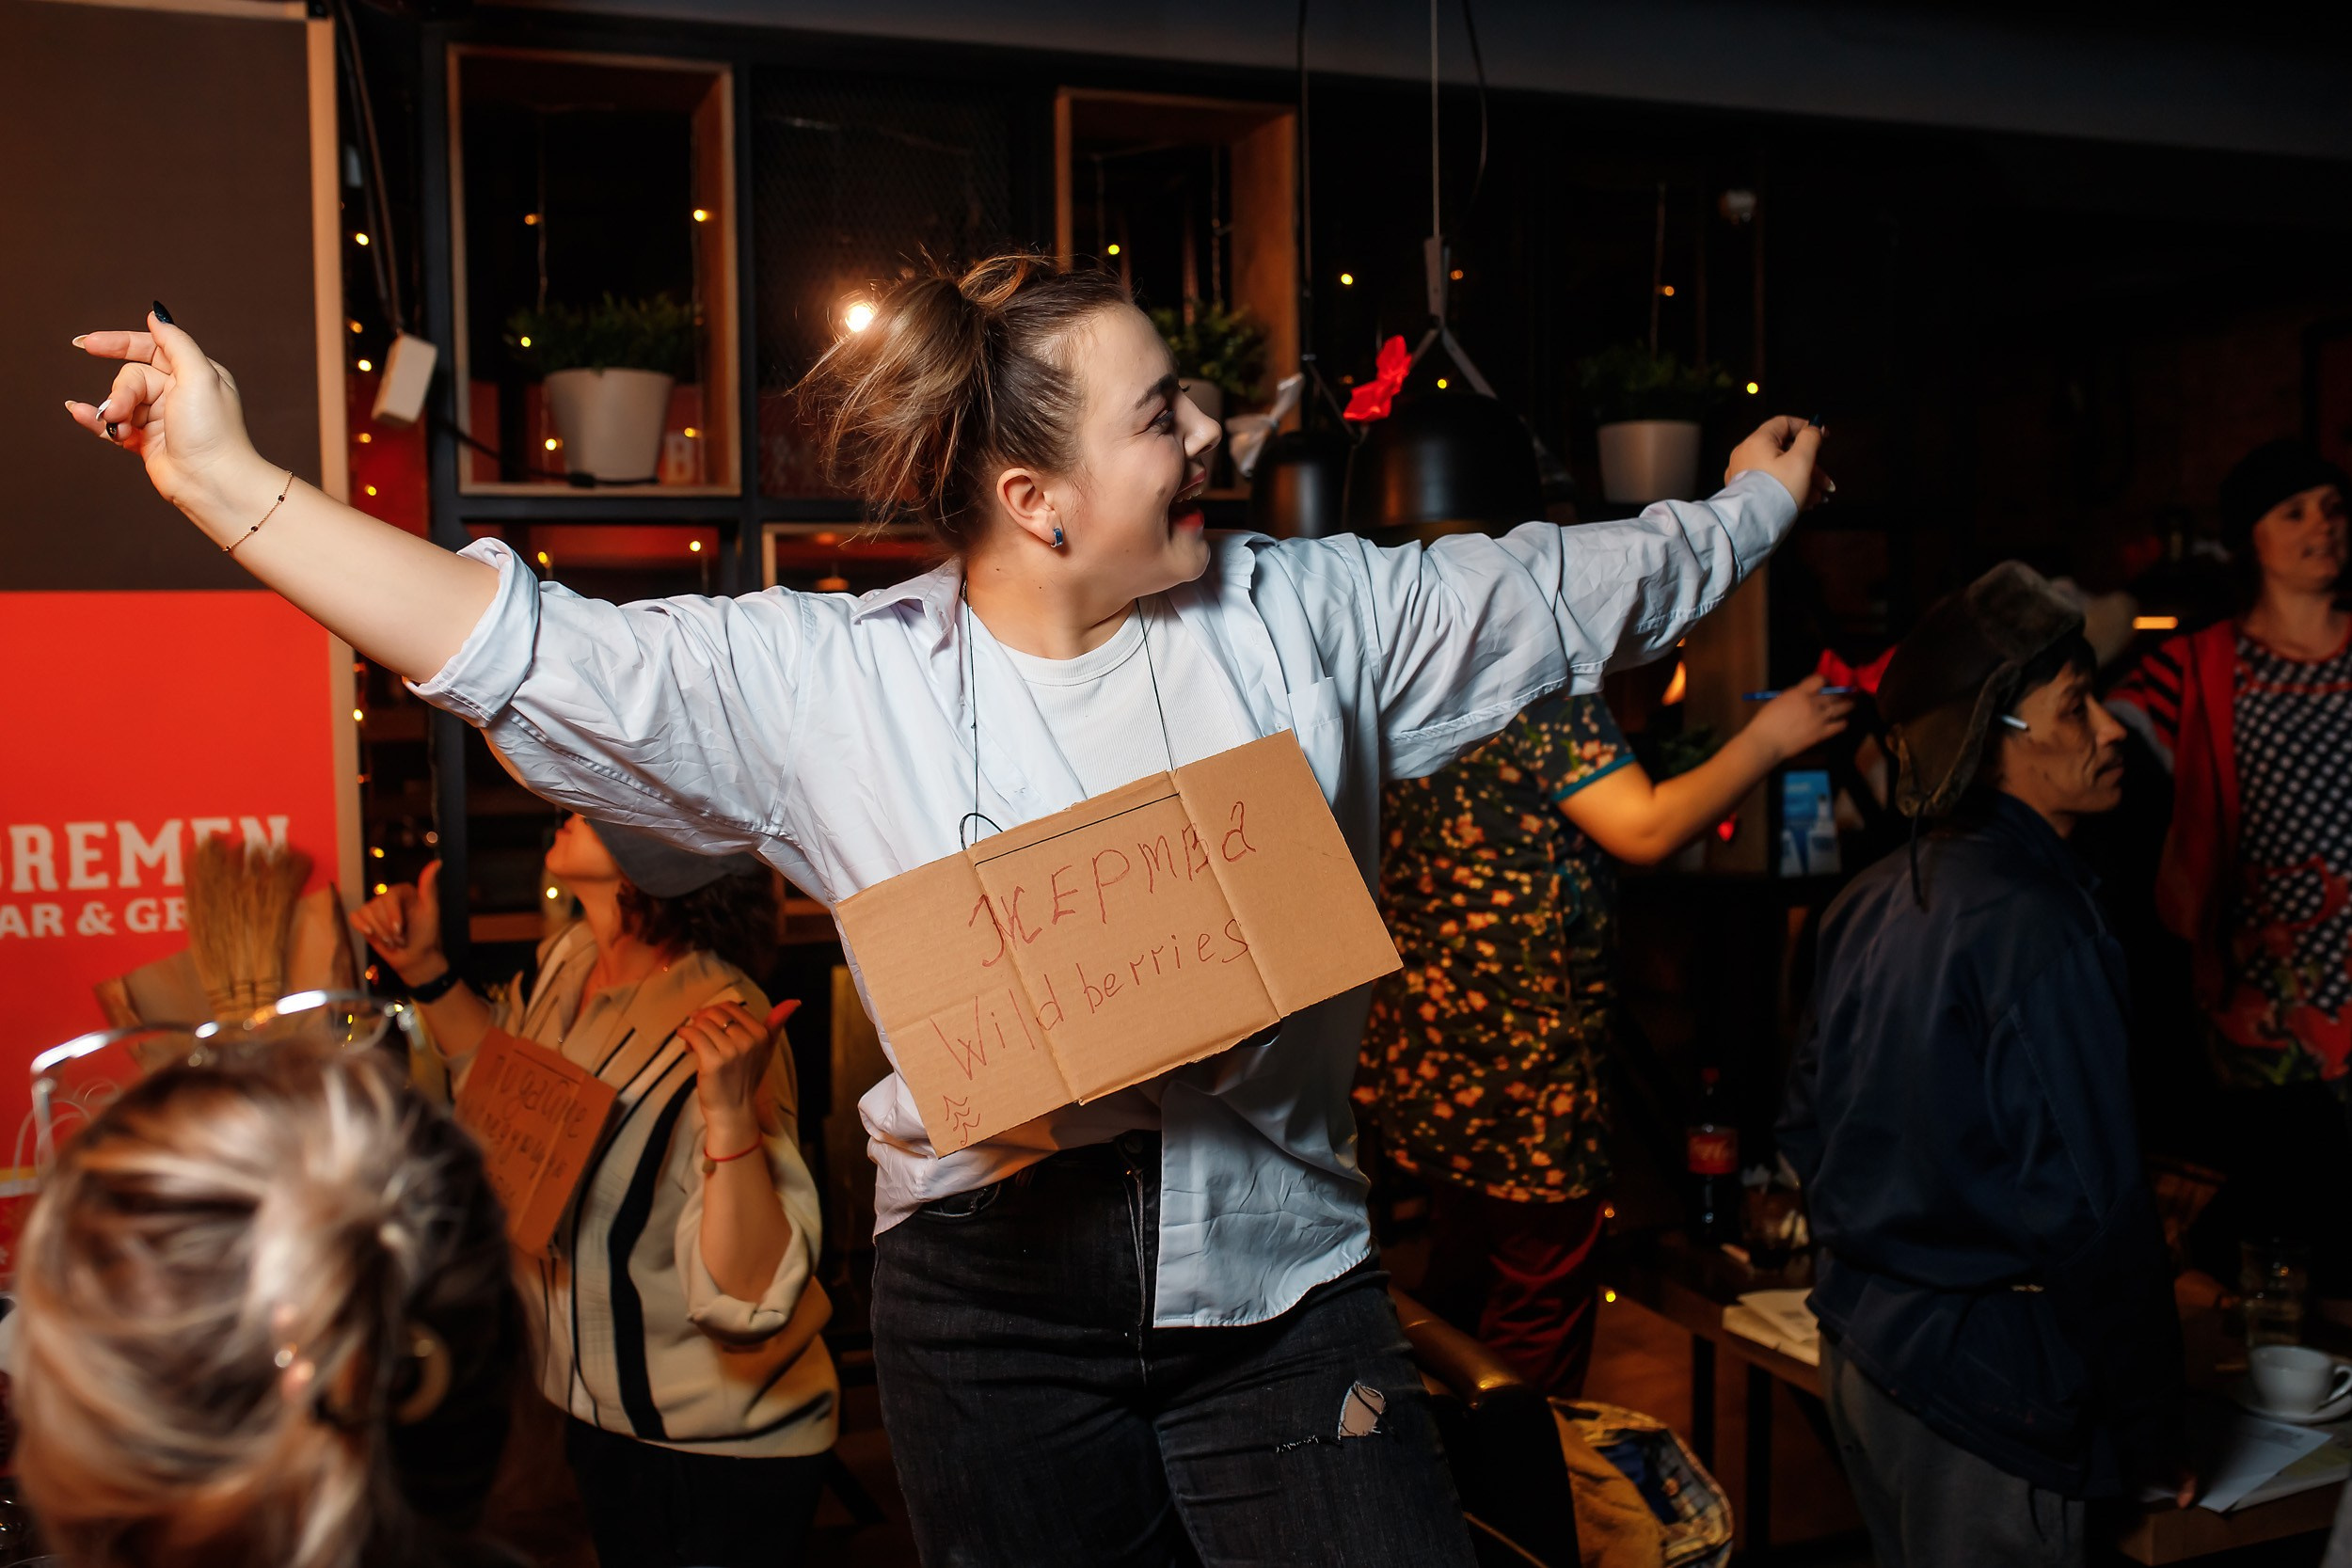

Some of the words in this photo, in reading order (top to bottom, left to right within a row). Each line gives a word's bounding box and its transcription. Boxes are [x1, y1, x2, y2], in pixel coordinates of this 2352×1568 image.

[0, 815, 289, 894] REMN
[0, 902, 66, 939] AR
[77, 900, 116, 937] &
